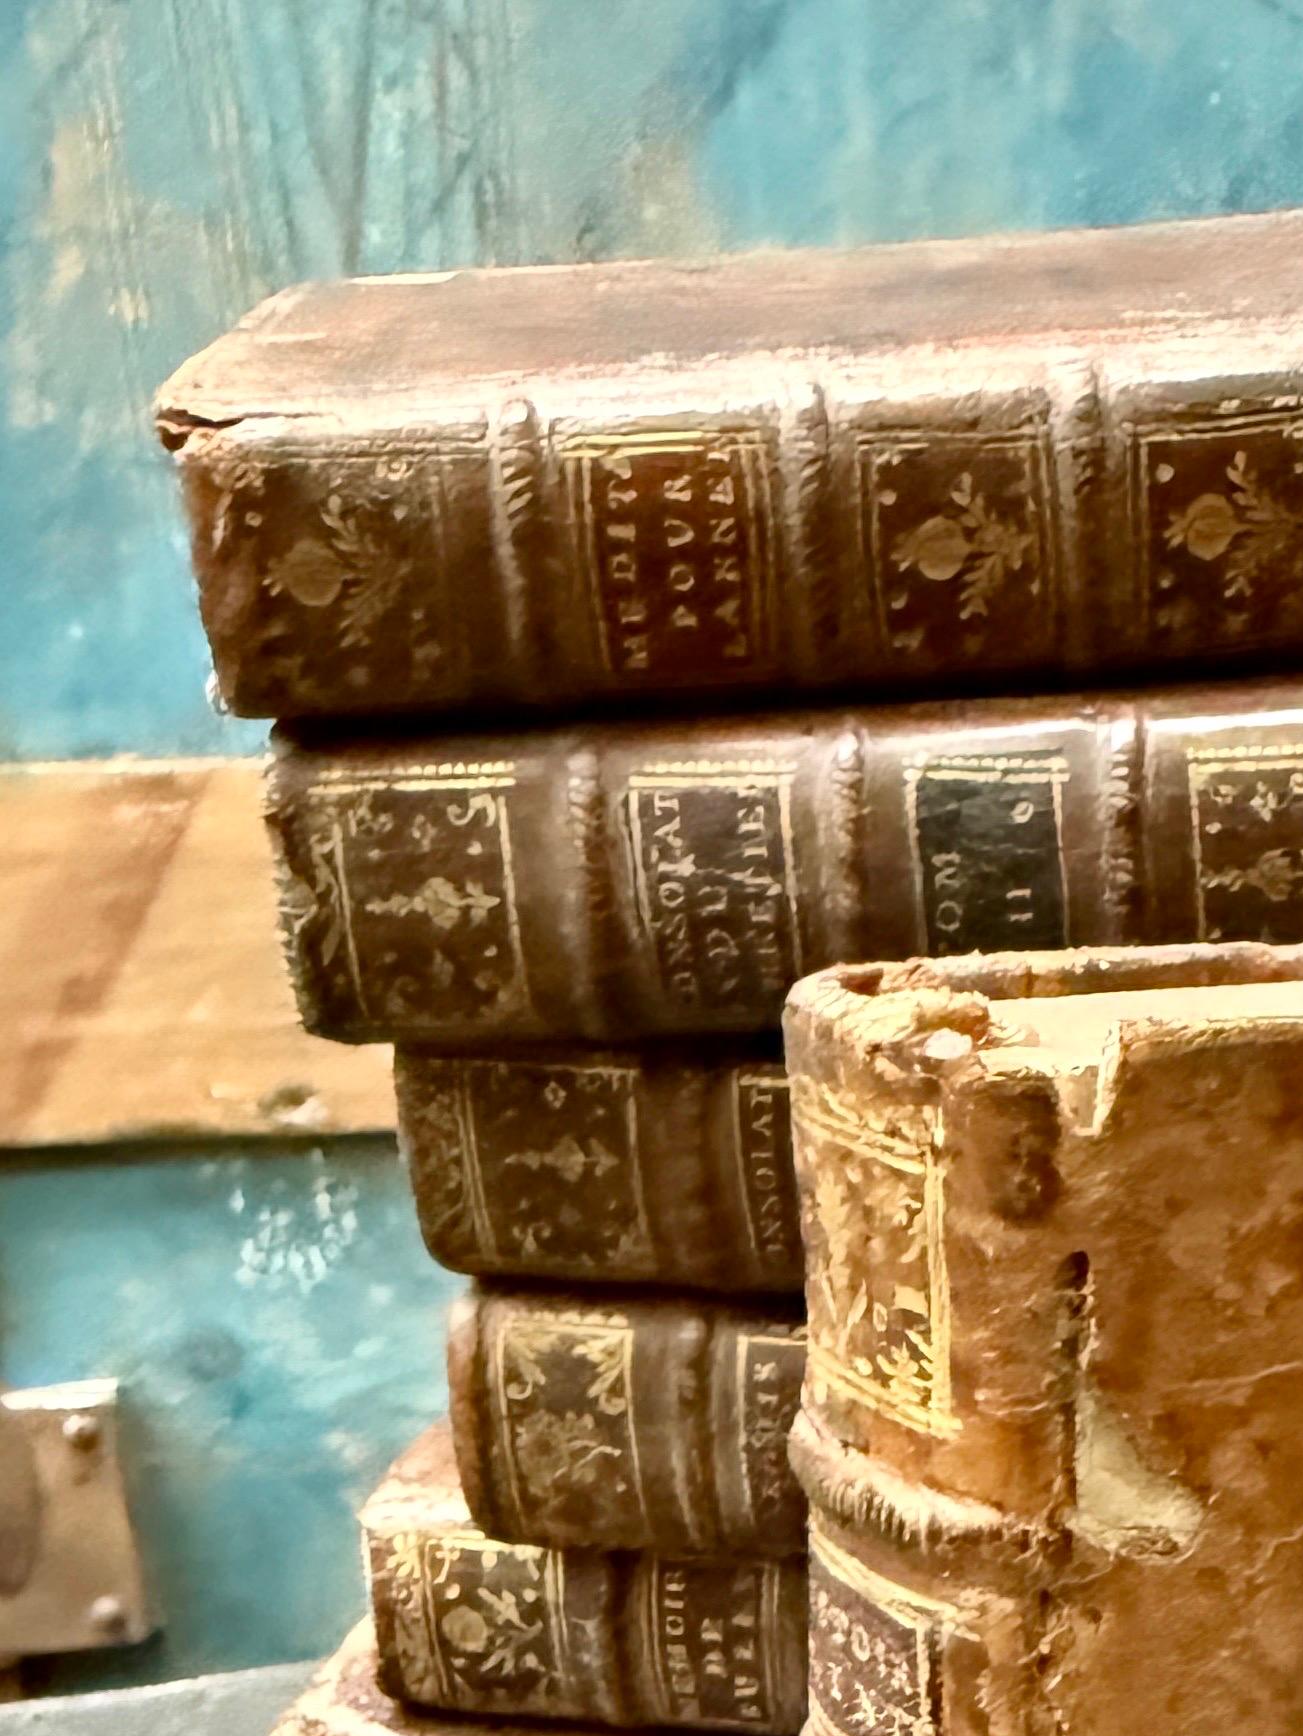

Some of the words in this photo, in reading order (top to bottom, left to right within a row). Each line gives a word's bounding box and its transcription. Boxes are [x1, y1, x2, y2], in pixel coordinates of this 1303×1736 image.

[662, 473, 699, 630] POUR
[931, 849, 968, 952] OM
[700, 1617, 729, 1680] DE
